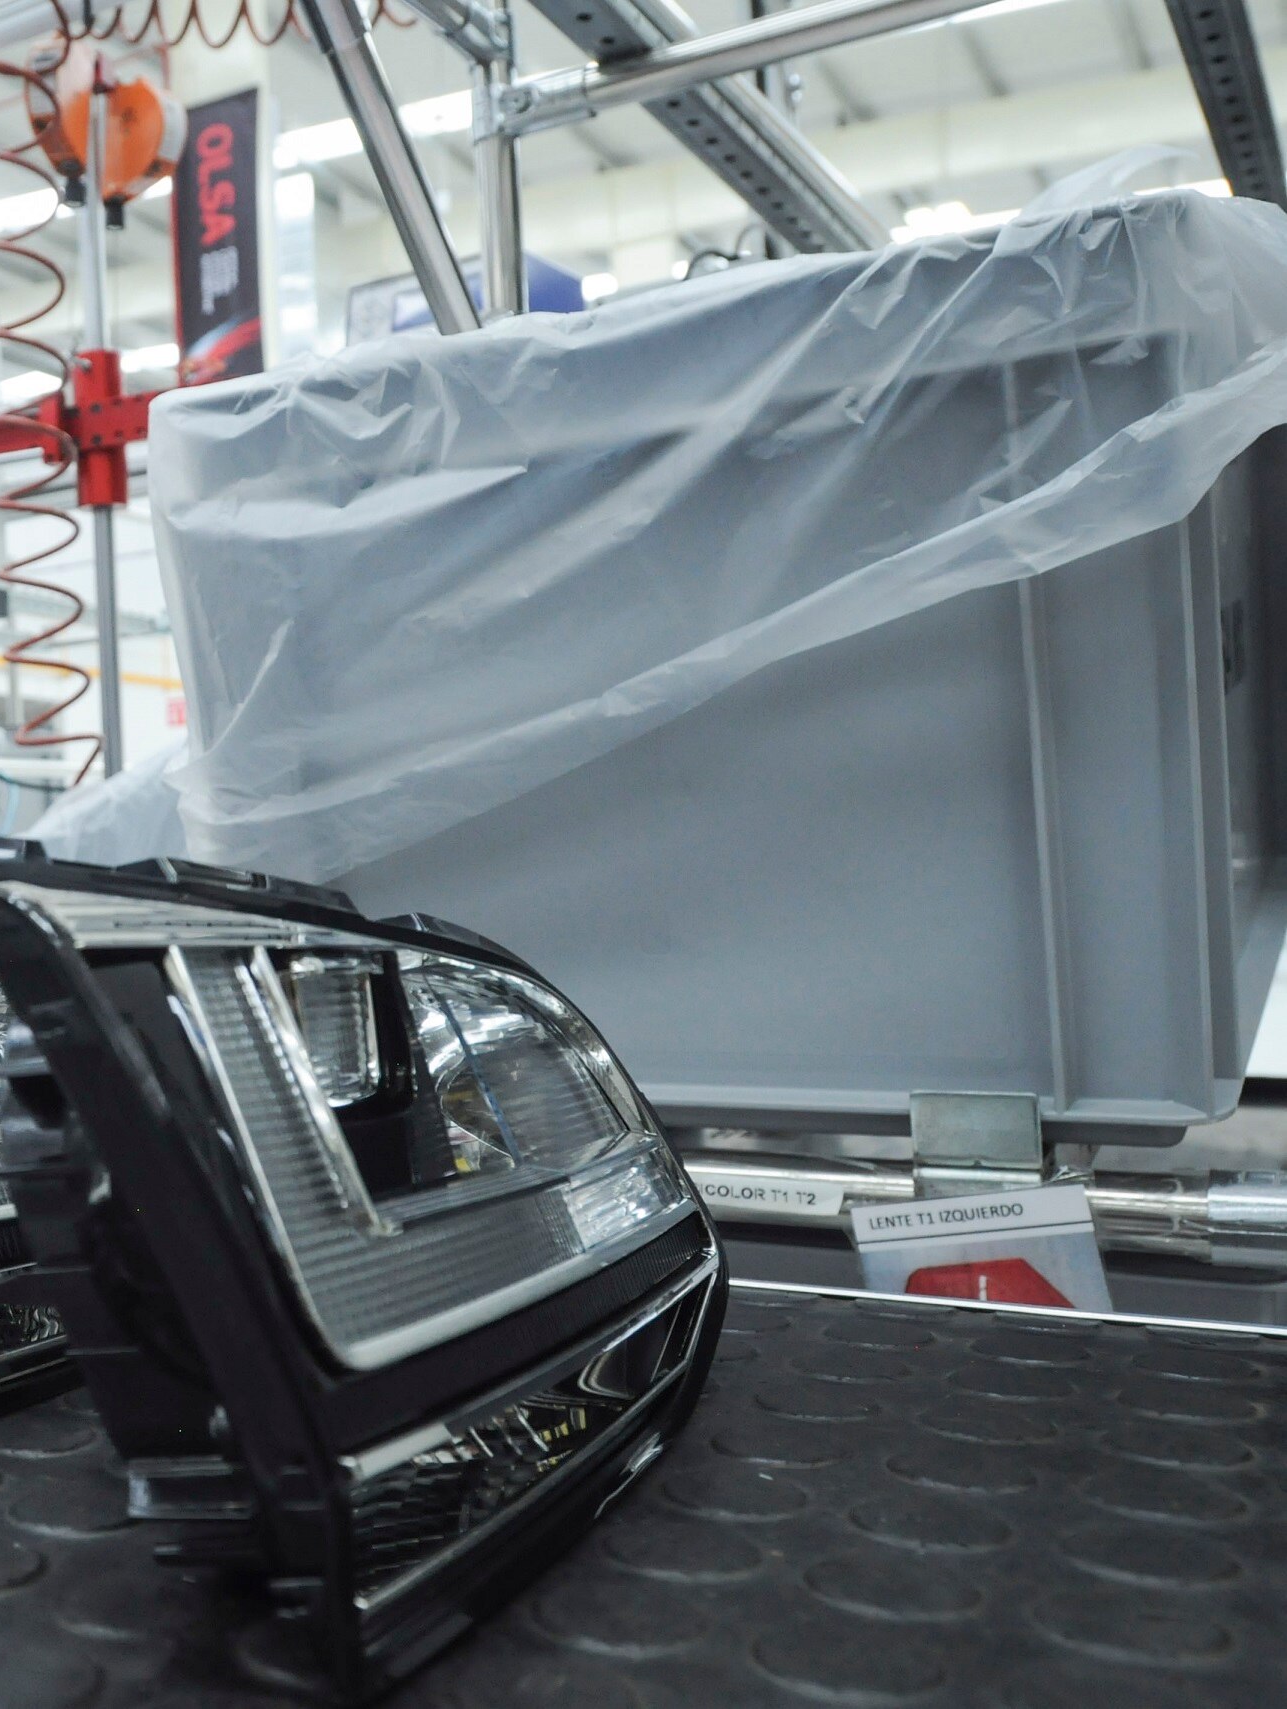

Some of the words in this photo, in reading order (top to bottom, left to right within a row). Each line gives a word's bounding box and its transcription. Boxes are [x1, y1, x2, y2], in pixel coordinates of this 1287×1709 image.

[196, 122, 237, 246] OLSA
[771, 1189, 789, 1203] T1
[796, 1191, 817, 1206] T2
[869, 1214, 912, 1231] LENTE
[917, 1211, 936, 1226] T1
[939, 1202, 1024, 1224] IZQUIERDO
